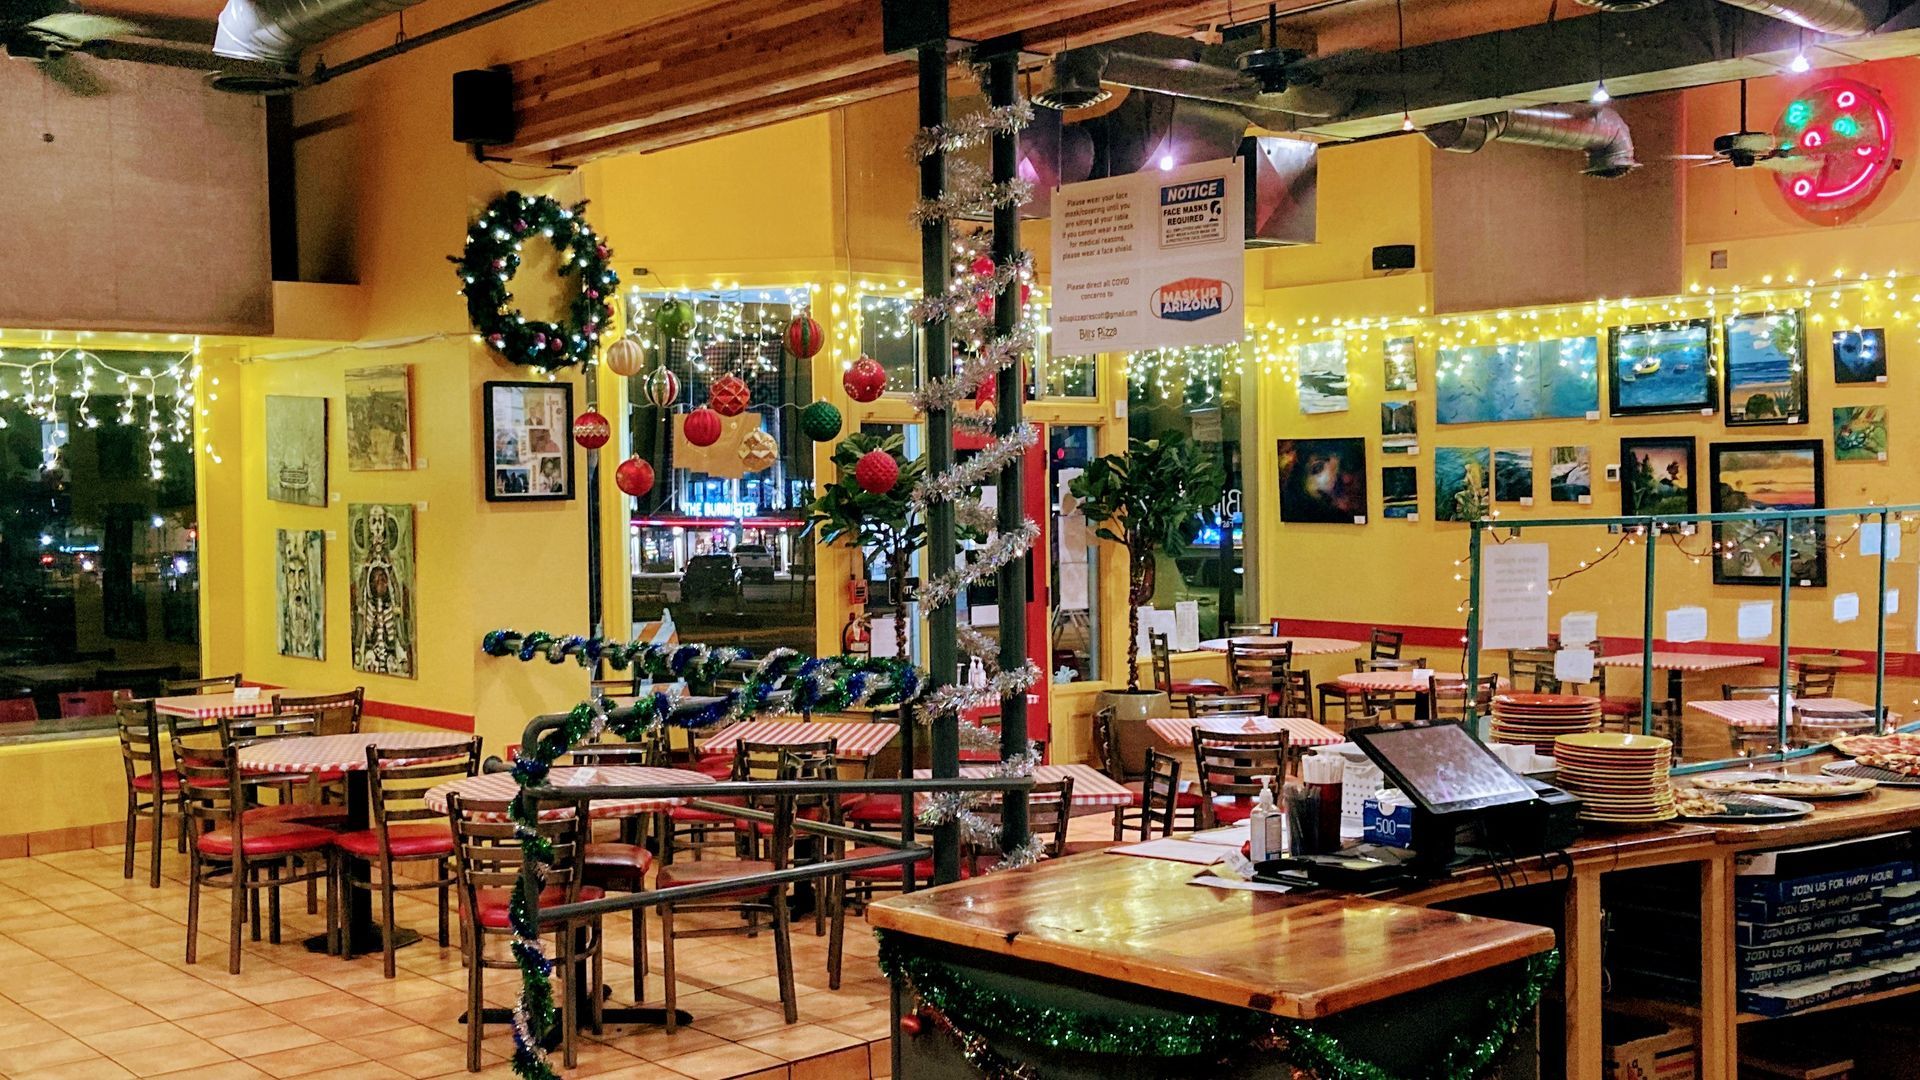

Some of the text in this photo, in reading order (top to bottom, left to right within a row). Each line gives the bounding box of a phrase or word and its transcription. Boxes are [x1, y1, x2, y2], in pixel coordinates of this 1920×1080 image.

[1066, 199, 1086, 207] Please
[1101, 194, 1115, 203] your
[1115, 192, 1128, 200] face
[1167, 182, 1218, 202] NOTICE
[1106, 203, 1120, 212] until
[1119, 203, 1131, 211] you
[1163, 203, 1208, 217] FACE MASKS
[1075, 218, 1093, 226] sitting
[1100, 215, 1114, 224] your
[1167, 214, 1204, 226] REQUIRED
[1067, 231, 1077, 240] you
[1077, 228, 1097, 237] cannot
[1097, 226, 1112, 234] wear
[1117, 223, 1134, 231] mask
[1078, 238, 1100, 247] medical
[1062, 251, 1081, 261] please
[1081, 249, 1096, 257] wear
[1101, 246, 1113, 254] face
[1066, 277, 1130, 291] Please direct all COVID
[1080, 292, 1106, 300] concerns
[1163, 286, 1219, 302] MASK UP
[1163, 297, 1220, 314] ARIZONA
[685, 501, 703, 517] THE
[1375, 818, 1397, 836] 500
[1792, 885, 1814, 897] JOIN
[1815, 882, 1827, 892] US
[1828, 879, 1845, 890] FOR
[1845, 874, 1869, 886] HAPPY
[1870, 869, 1894, 882] HOUR!
[1761, 928, 1783, 940] JOIN
[1784, 925, 1796, 936] US
[1796, 922, 1813, 933] FOR
[1813, 917, 1837, 929] HAPPY
[1745, 950, 1770, 962] JOIN
[1772, 947, 1785, 958] US
[1787, 944, 1805, 956] FOR
[1807, 940, 1834, 953] HAPPY
[1836, 937, 1863, 950] HOUR!
[1750, 970, 1772, 983] JOIN
[1773, 967, 1786, 977] US
[1786, 964, 1802, 975] FOR
[1804, 959, 1828, 971] HAPPY
